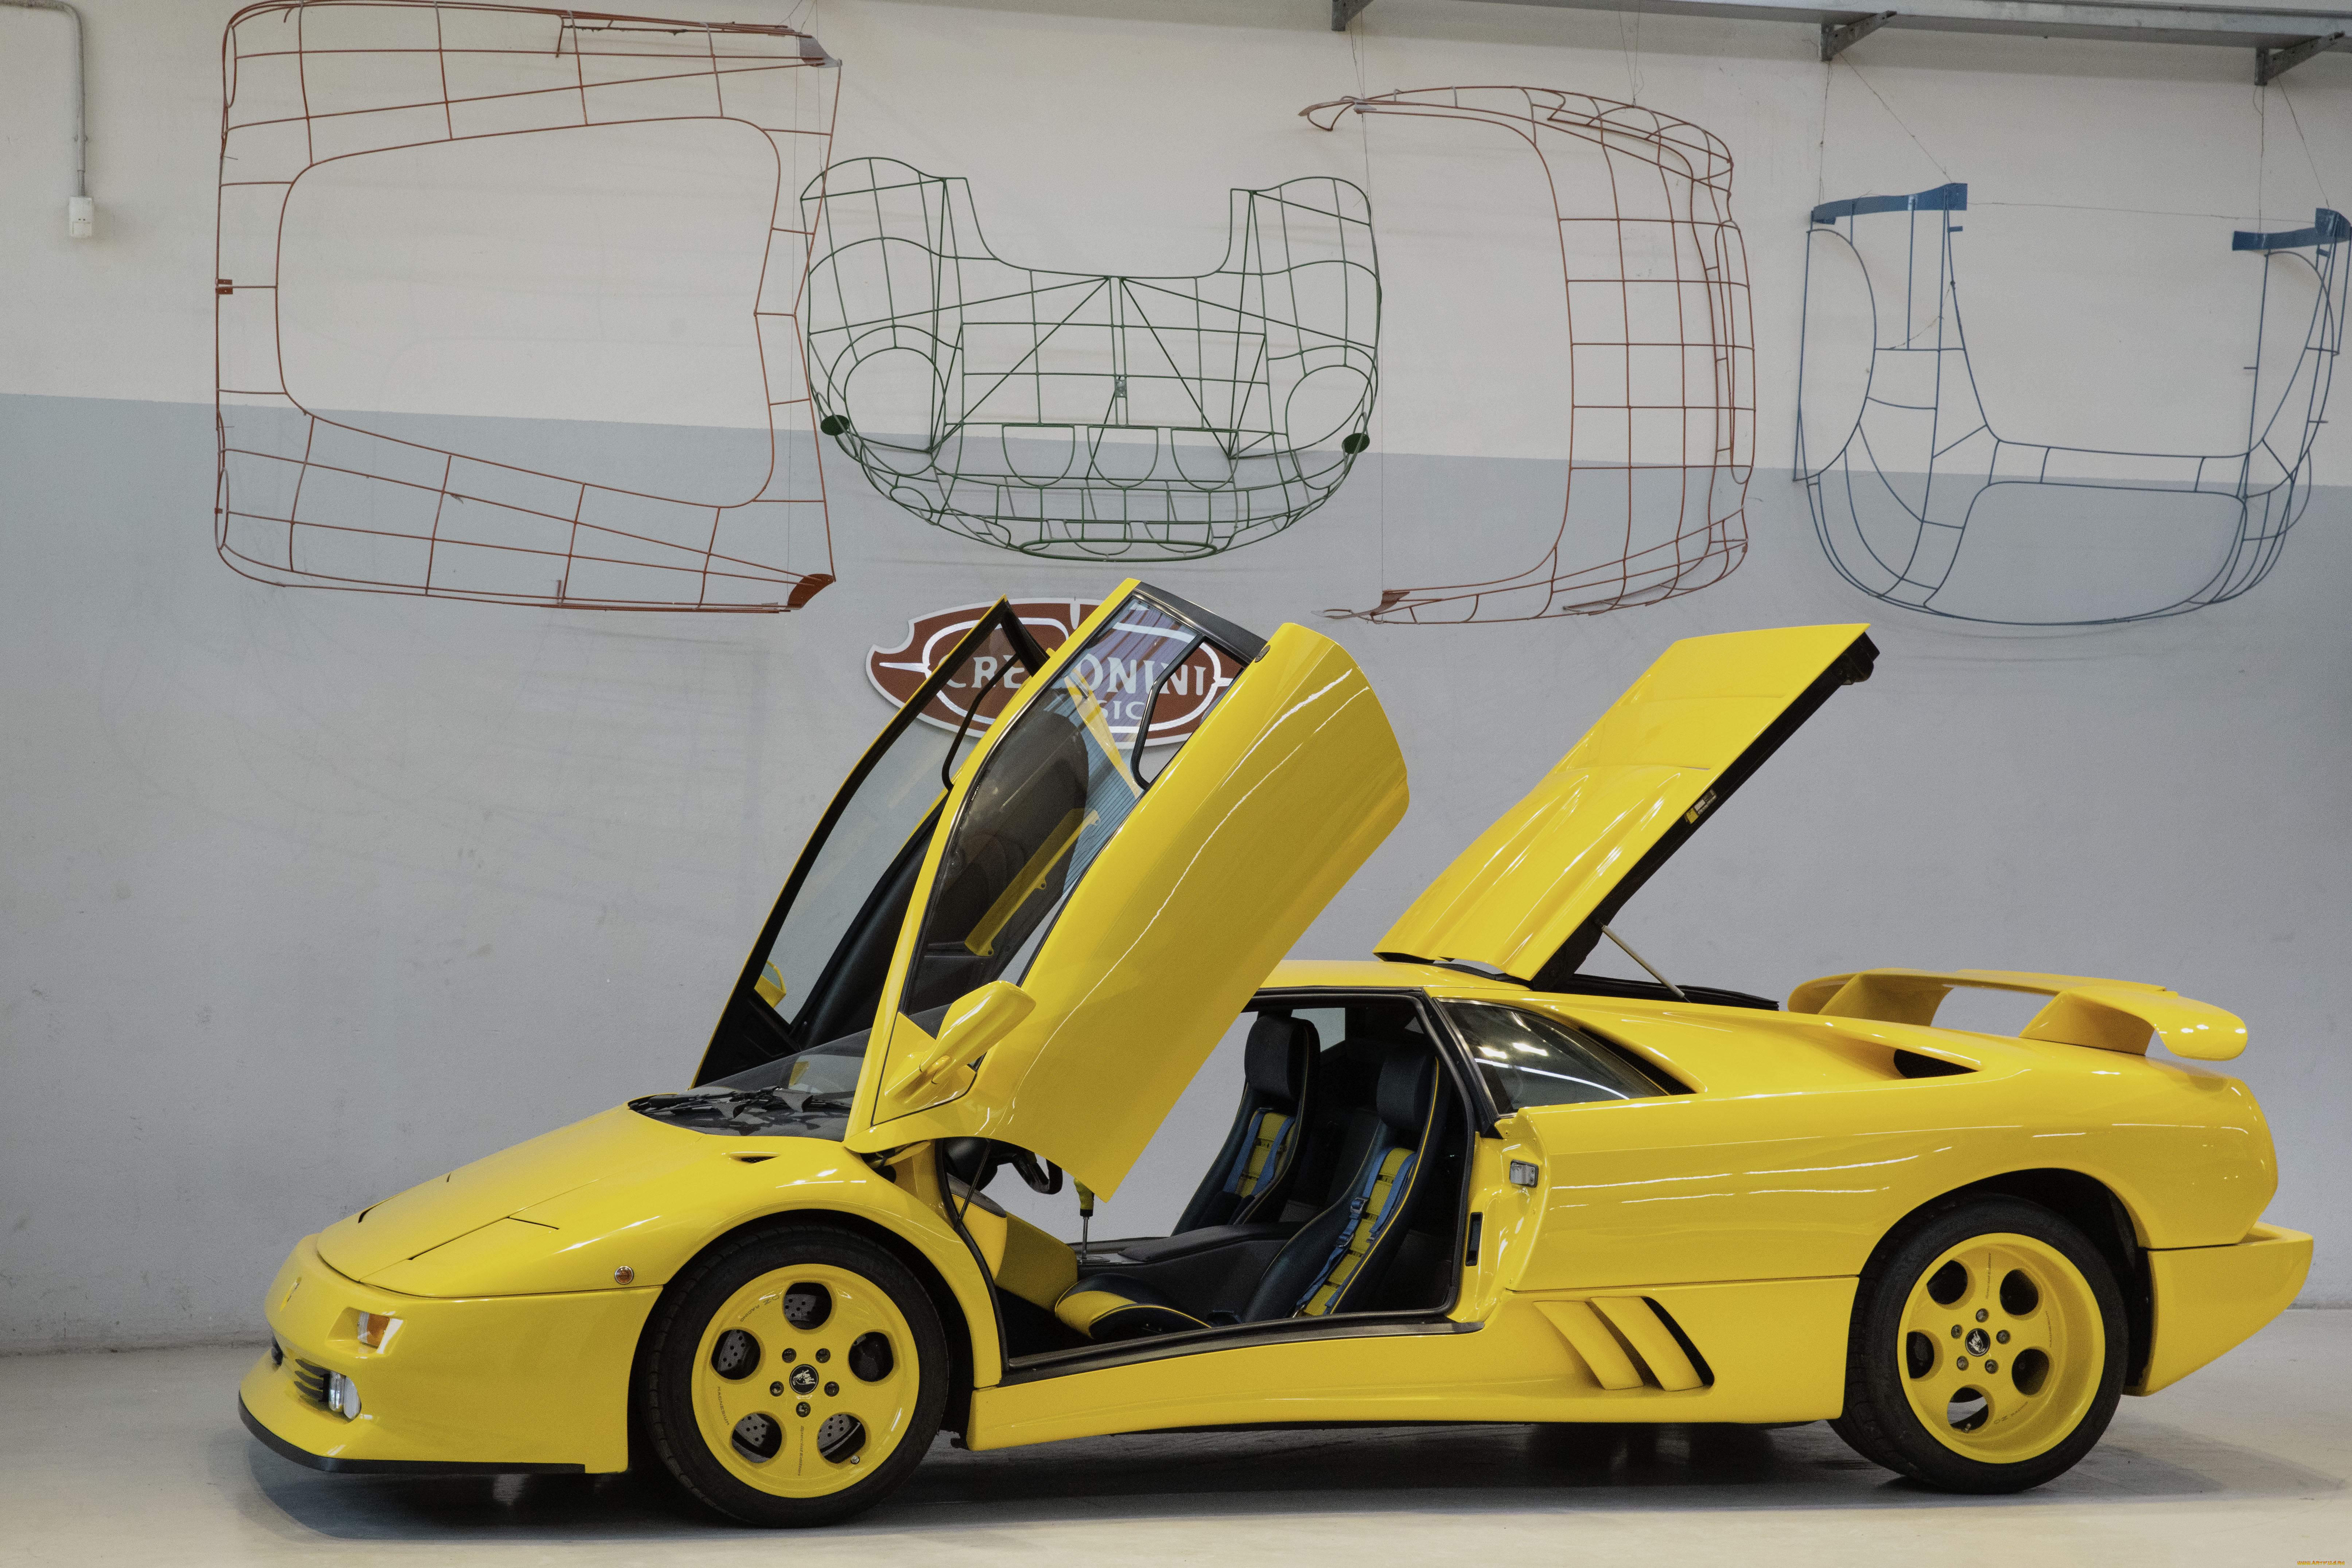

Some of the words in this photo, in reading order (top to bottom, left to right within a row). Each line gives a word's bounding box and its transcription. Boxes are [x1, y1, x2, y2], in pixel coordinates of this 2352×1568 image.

[939, 653, 1206, 696] REONINI
[740, 1304, 760, 1322] RACING
[718, 1386, 730, 1425] MAGNESIUM
